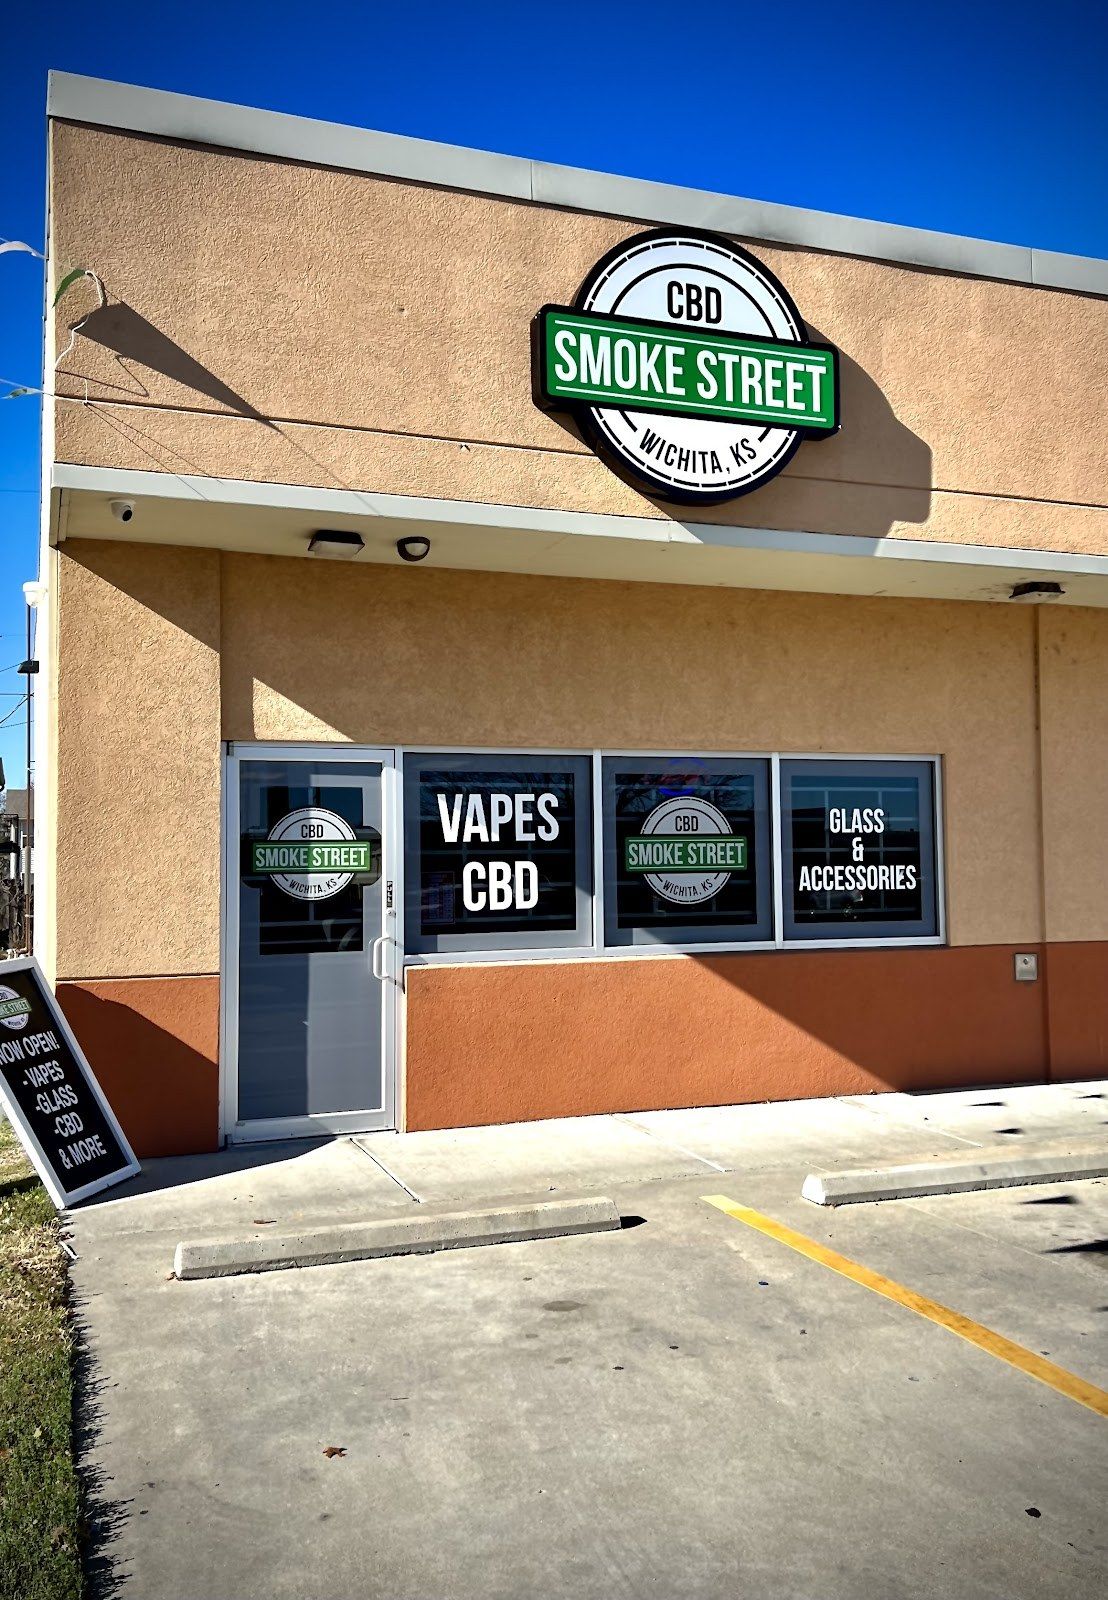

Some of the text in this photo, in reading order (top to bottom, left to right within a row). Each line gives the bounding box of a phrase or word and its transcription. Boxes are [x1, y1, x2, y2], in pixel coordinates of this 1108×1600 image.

[667, 281, 722, 324] CBD
[554, 329, 827, 413] SMOKE STREET
[639, 428, 757, 474] WICHITA, KS
[301, 824, 324, 838] CBD
[437, 793, 560, 843] VAPES
[675, 815, 699, 832] CBD
[829, 808, 885, 834] GLASS
[255, 847, 367, 867] SMOKE STREET
[628, 842, 744, 866] SMOKE STREET
[852, 836, 864, 862] &
[289, 878, 337, 894] WICHITA, KS
[462, 861, 539, 912] CBD
[662, 878, 713, 897] WICHITA, KS
[799, 865, 917, 891] ACCESSORIES
[22, 1030, 60, 1057] OPEN!
[22, 1060, 65, 1087] -VAPES
[35, 1084, 79, 1116] -GLASS
[54, 1111, 84, 1138] -CBD
[58, 1134, 107, 1170] & MORE
